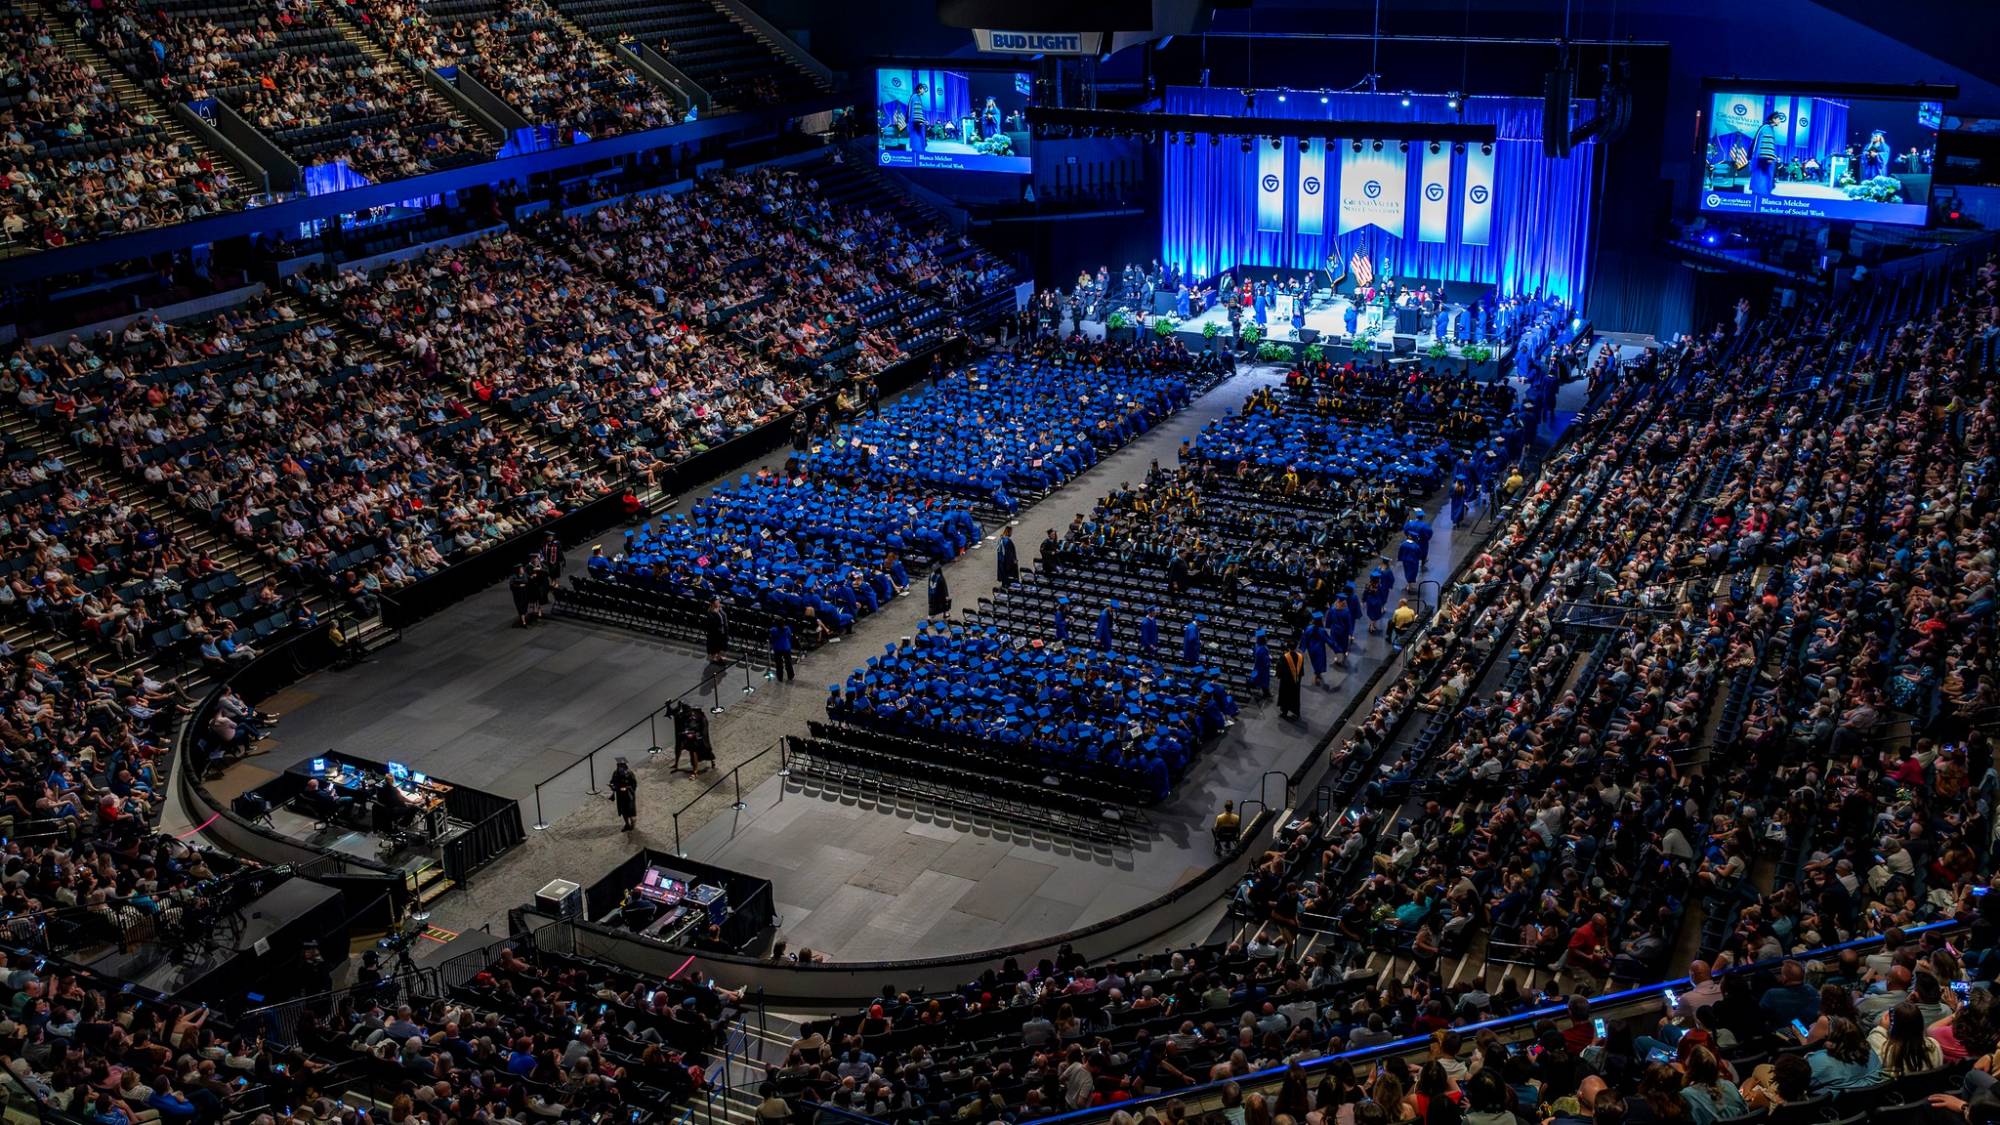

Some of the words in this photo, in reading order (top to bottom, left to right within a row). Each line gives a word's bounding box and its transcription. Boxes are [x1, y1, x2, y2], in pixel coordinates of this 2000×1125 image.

[993, 33, 1027, 49] BUD
[1028, 35, 1078, 50] LIGHT
[1761, 198, 1782, 206] Blanca
[1783, 200, 1810, 208] Melchor
